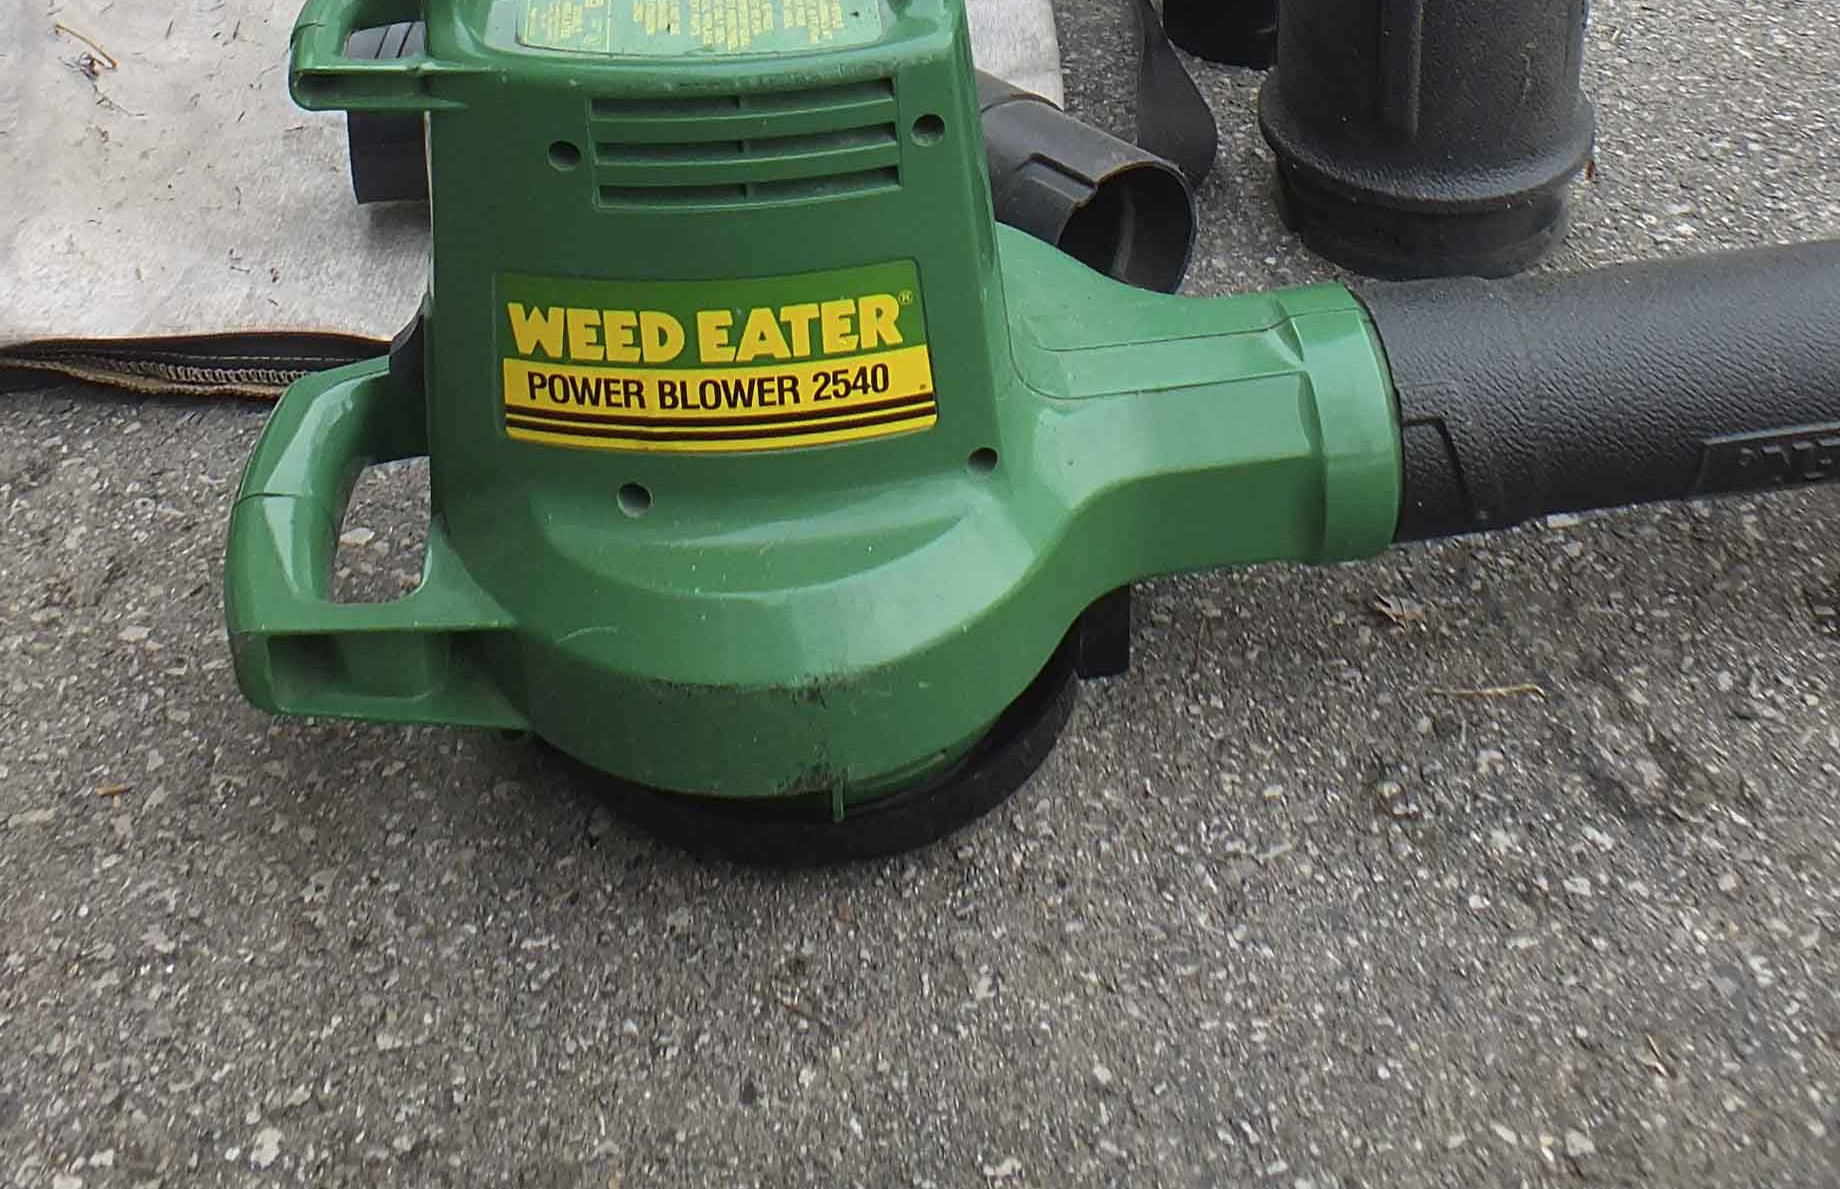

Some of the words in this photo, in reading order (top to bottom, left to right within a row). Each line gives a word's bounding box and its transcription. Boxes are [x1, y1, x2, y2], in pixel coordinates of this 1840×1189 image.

[507, 302, 686, 364] WEED
[527, 370, 646, 409] POWER
[657, 375, 802, 411] BLOWER
[812, 363, 890, 402] 2540
